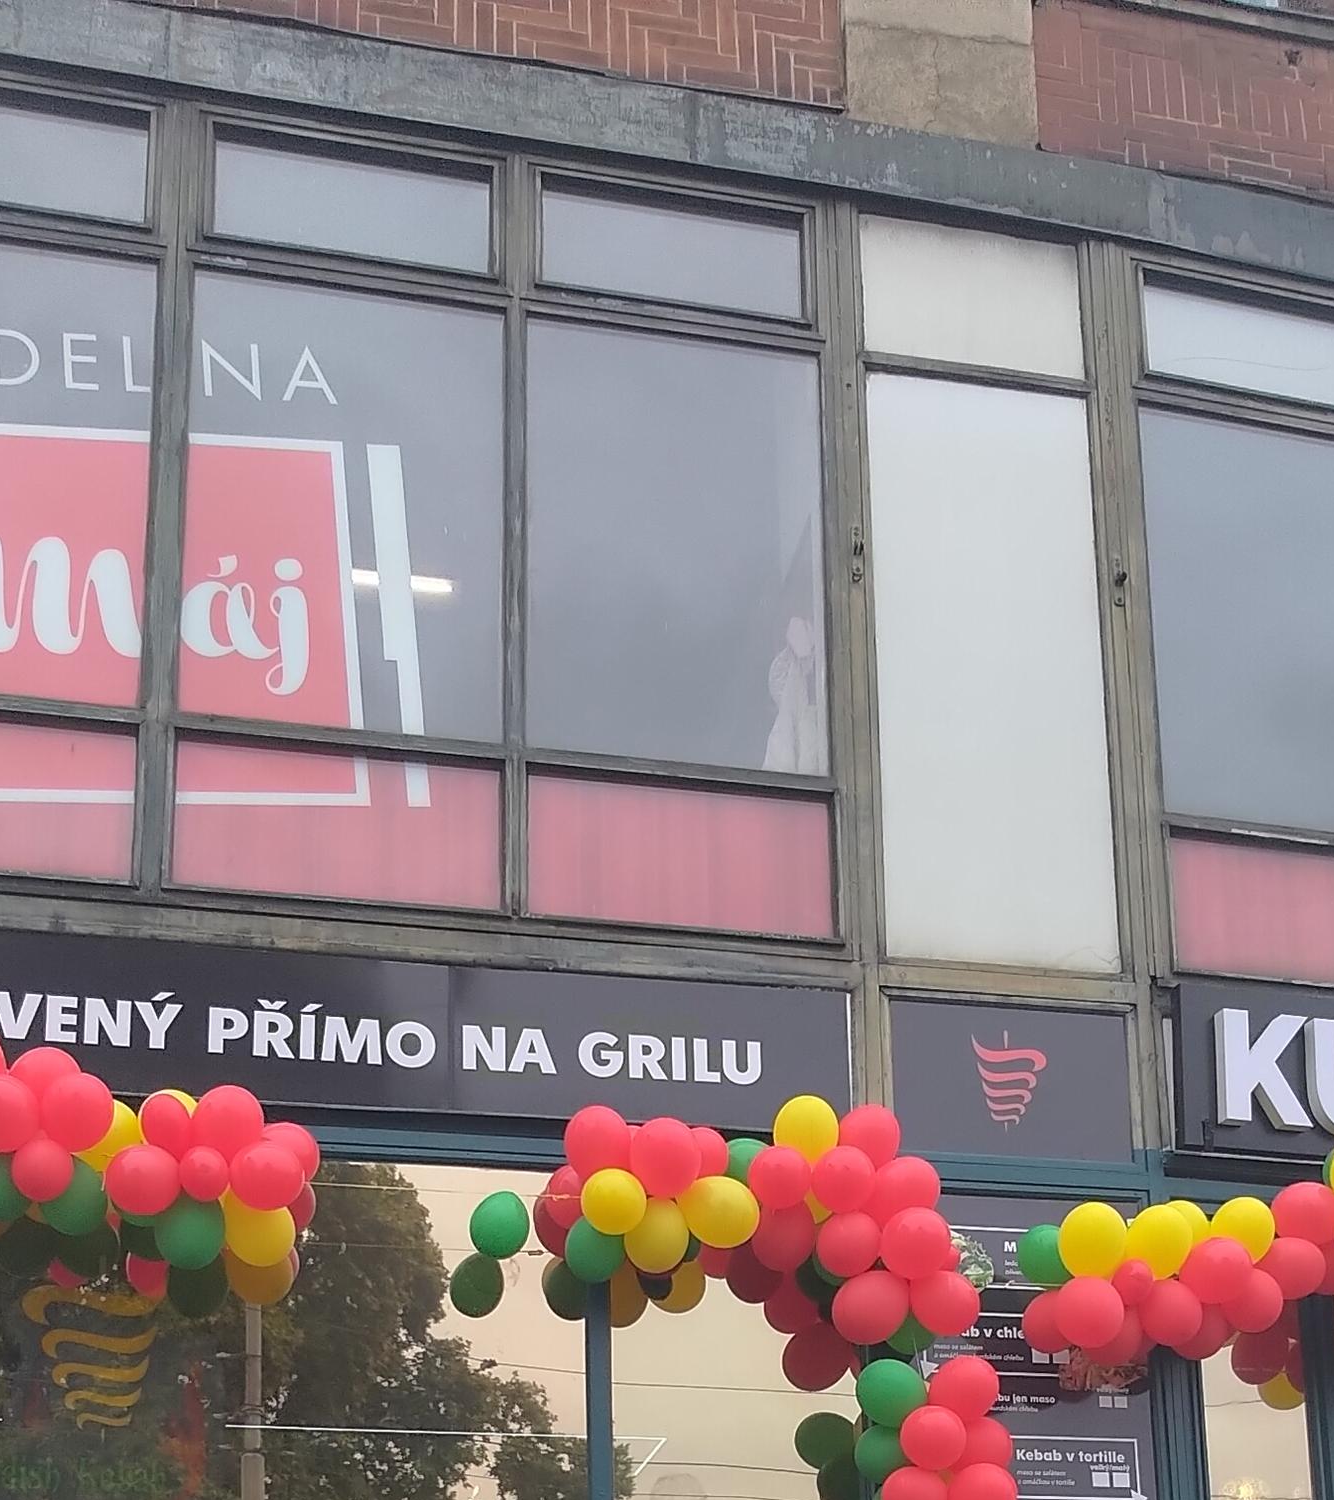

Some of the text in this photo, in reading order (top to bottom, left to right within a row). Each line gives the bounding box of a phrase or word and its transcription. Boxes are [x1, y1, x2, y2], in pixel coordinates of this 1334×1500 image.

[207, 998, 437, 1070] PŘÍMO
[461, 1024, 557, 1076] NA
[577, 1031, 763, 1086] GRILU
[996, 1326, 1025, 1340] chle
[1012, 1394, 1028, 1404] jen
[1030, 1395, 1056, 1404] maso
[1015, 1449, 1126, 1463] Kebab v tortille
